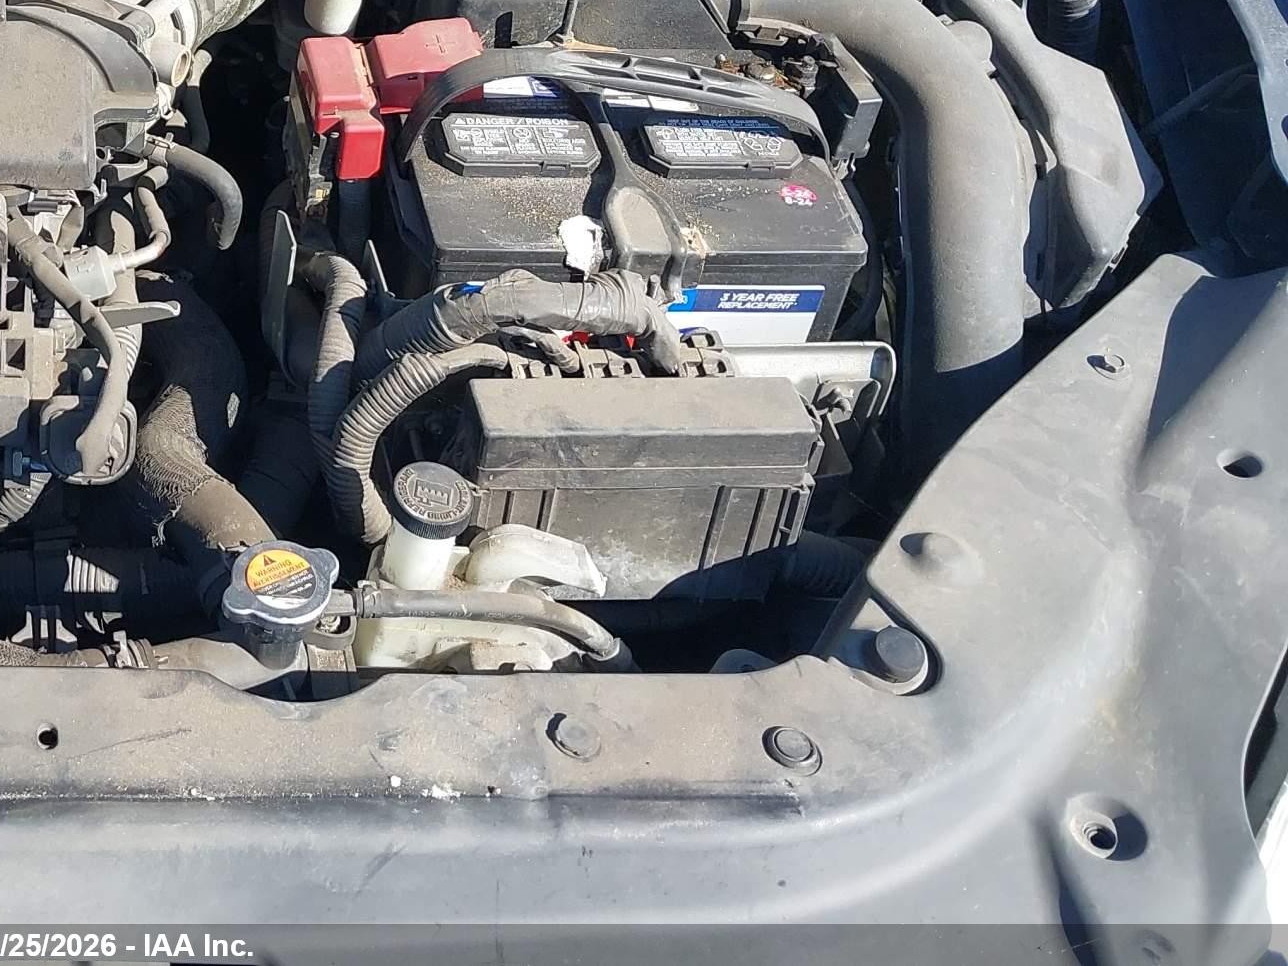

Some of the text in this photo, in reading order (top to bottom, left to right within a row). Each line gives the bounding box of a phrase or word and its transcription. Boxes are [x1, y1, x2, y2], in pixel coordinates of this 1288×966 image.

[467, 117, 514, 126] DANGER
[525, 117, 569, 126] POISON
[720, 293, 800, 302] 3 YEAR FREE
[255, 559, 292, 577] WARNING
